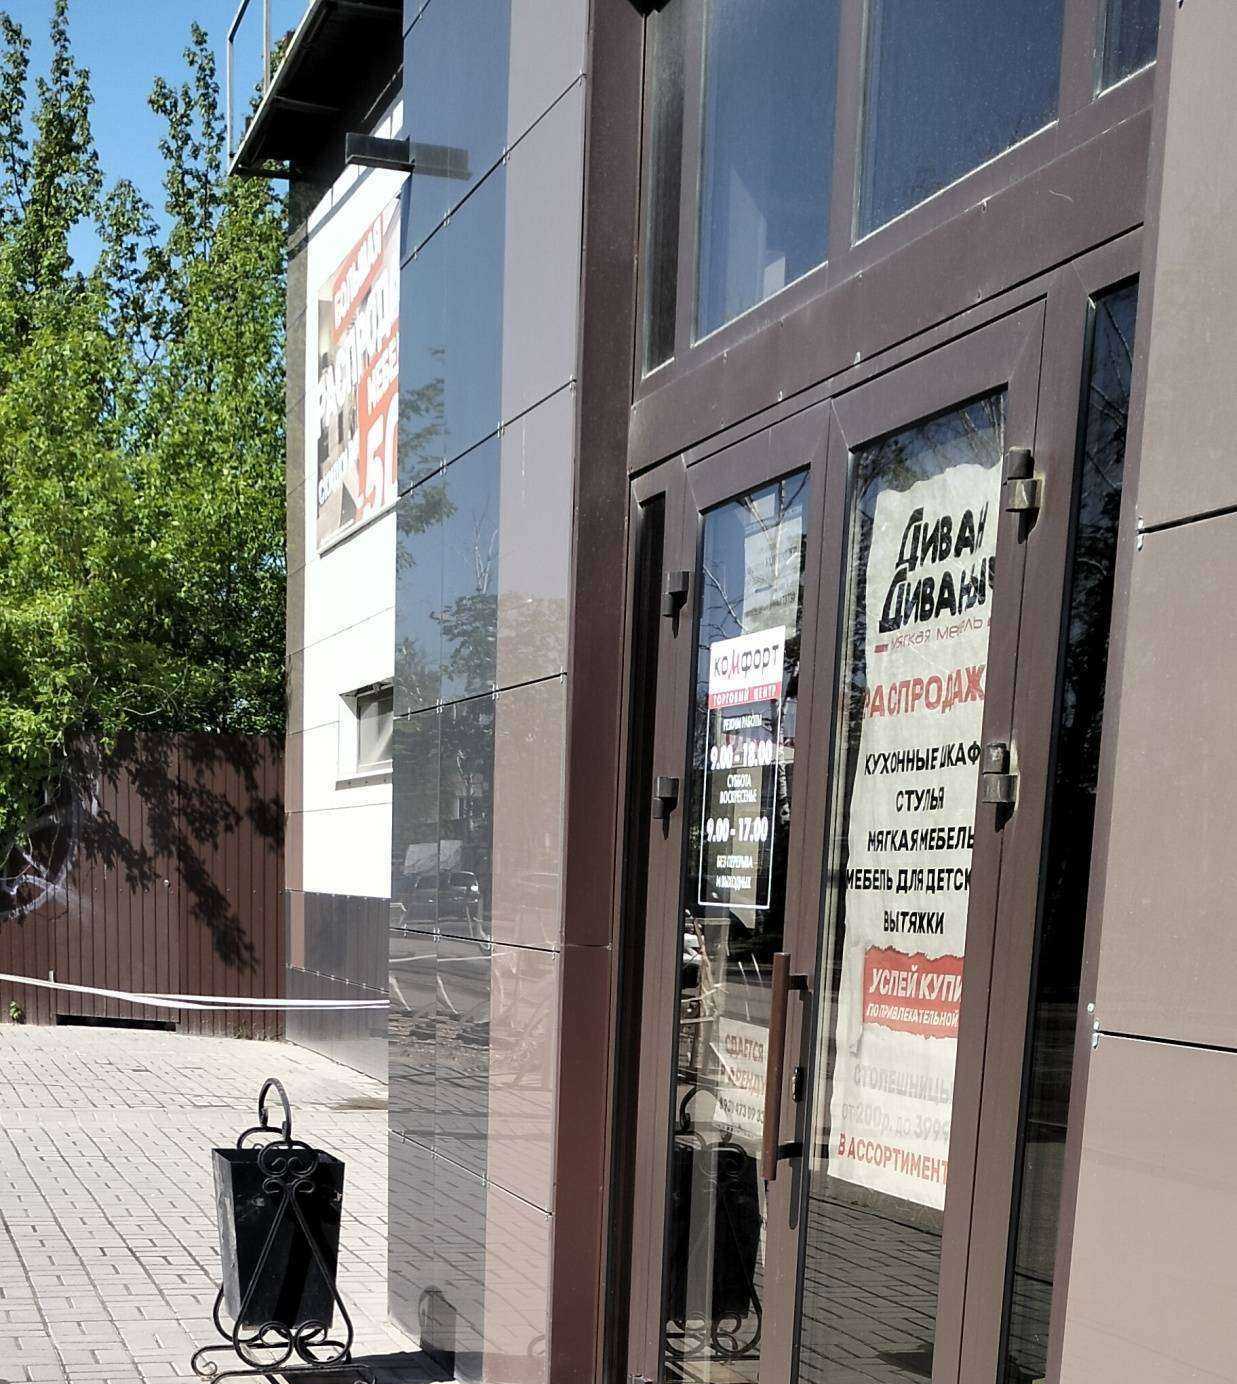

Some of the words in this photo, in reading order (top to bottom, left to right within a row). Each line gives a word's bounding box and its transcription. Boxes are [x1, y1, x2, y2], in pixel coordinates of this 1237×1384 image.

[753, 684, 776, 702] ЦЕНТР
[710, 744, 734, 770] 9.00
[743, 739, 773, 767] 18.00
[865, 747, 938, 776] КУХОННЫЕ
[727, 774, 752, 788] СУББОТА
[720, 787, 757, 804] ВОСКРЕСЕНЬЕ
[895, 786, 944, 813] СТУЛЬЯ
[706, 817, 731, 843] 9.00
[738, 816, 769, 843] 17.00
[867, 828, 919, 852] МЯГКАЯ
[717, 856, 727, 869] БЕЗ
[846, 868, 893, 891] МЕБЕЛЬ
[895, 868, 924, 894] ДЛЯ
[883, 911, 945, 934] ВЫТЯЖКИ
[869, 964, 918, 997] УСПЕЙ
[866, 1003, 878, 1018] ПО
[878, 1005, 959, 1028] ПРИВЛЕКАТЕЛЬНОЙ
[837, 1132, 846, 1157] В
